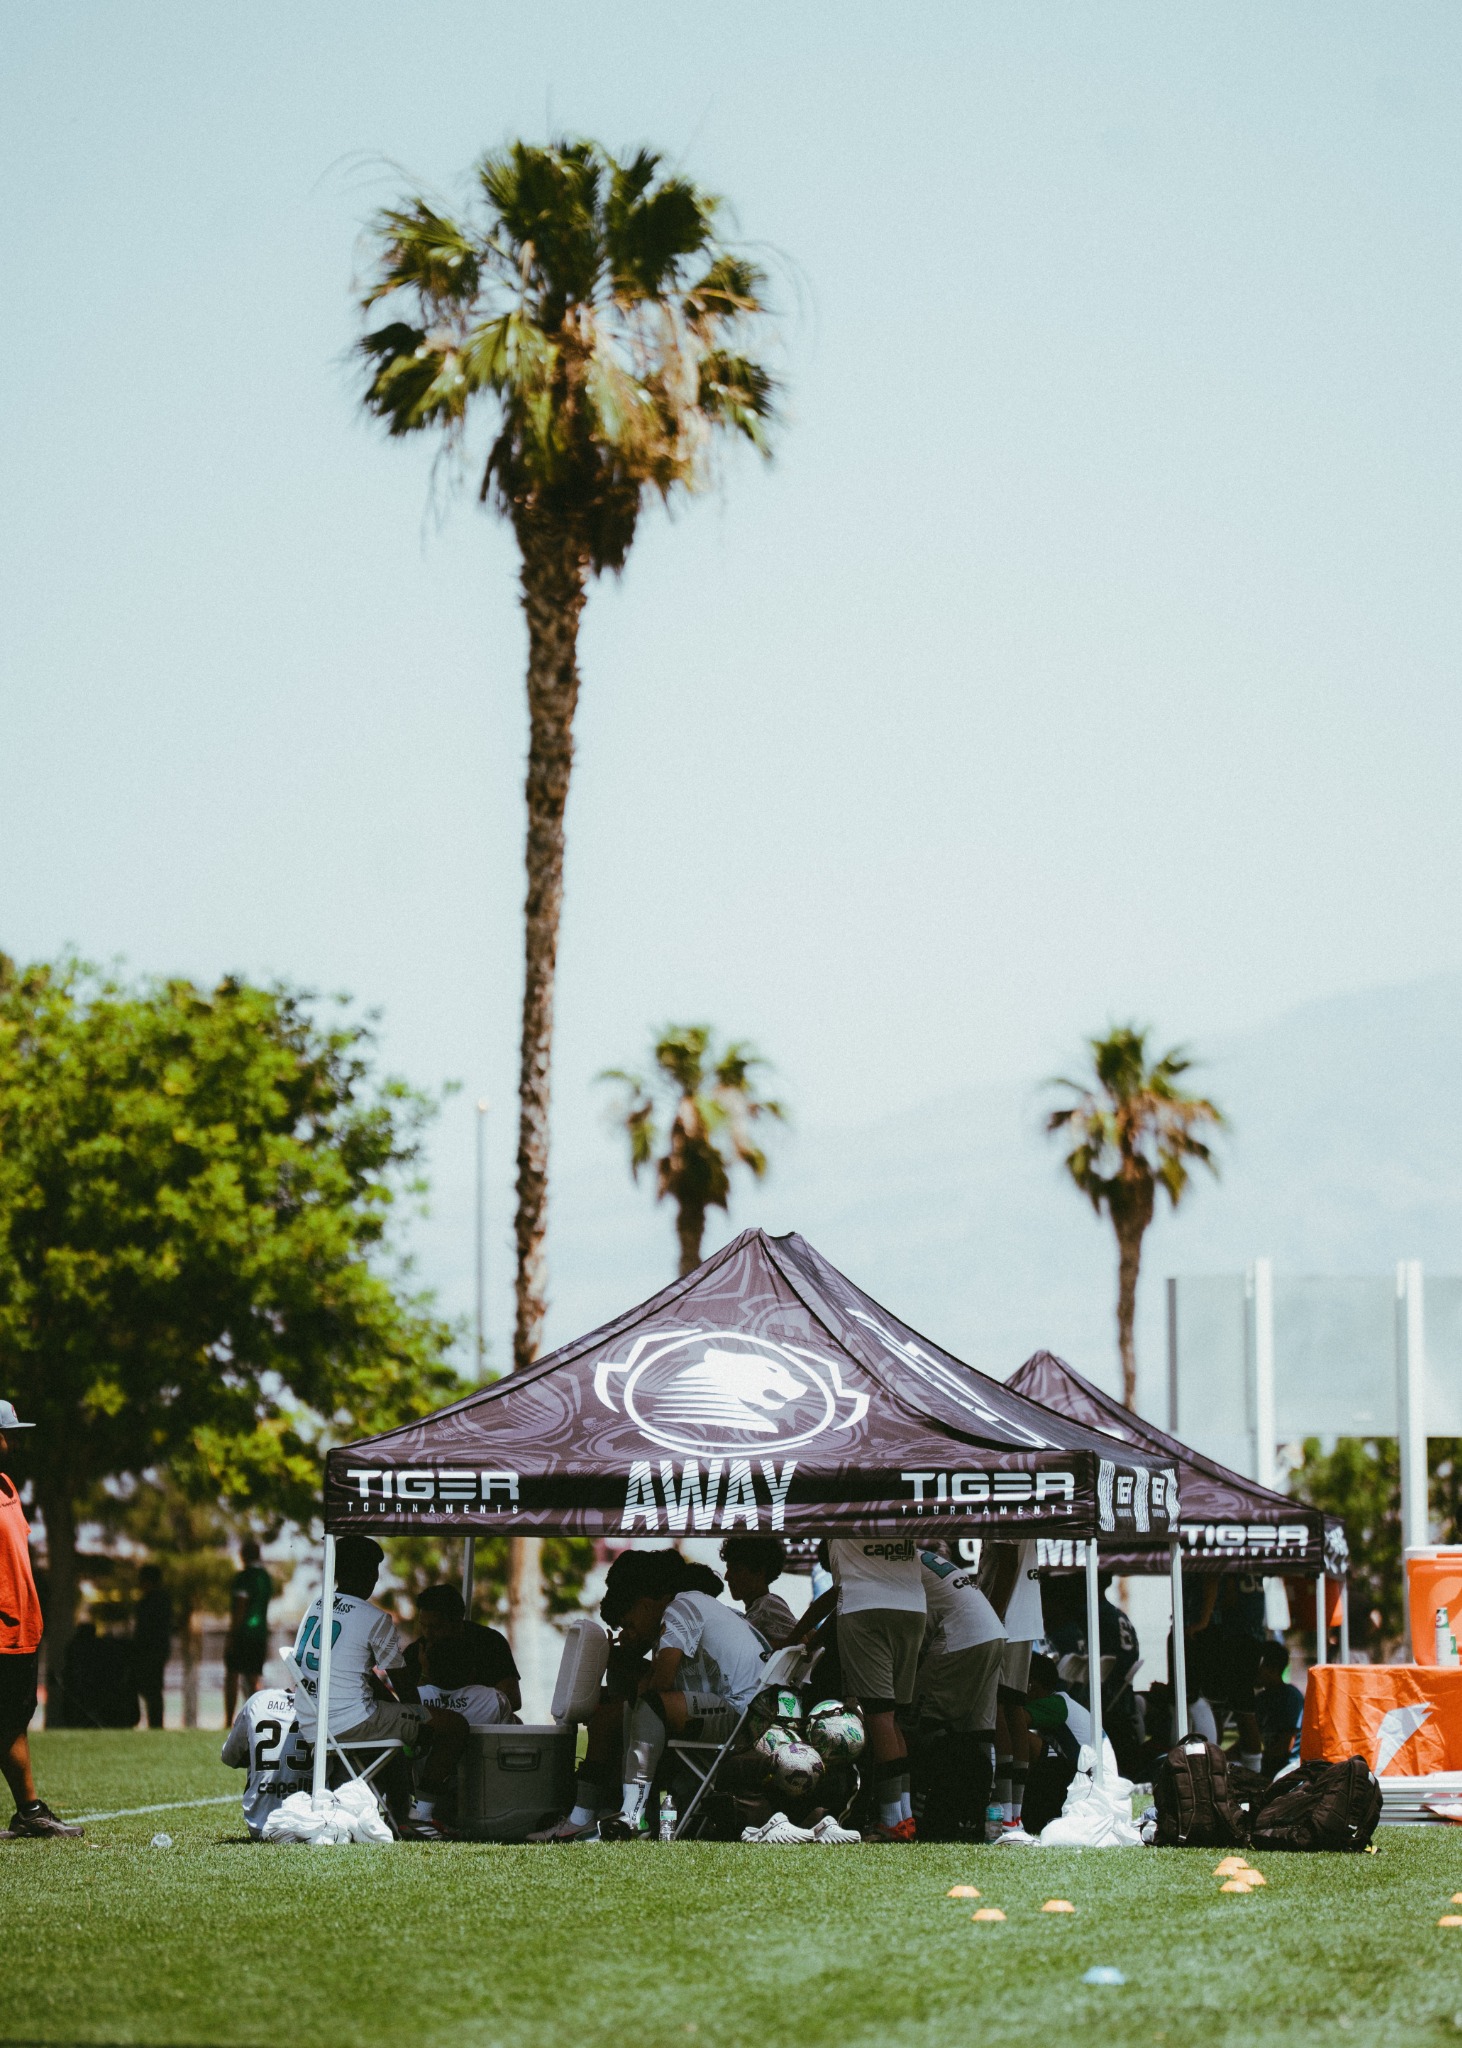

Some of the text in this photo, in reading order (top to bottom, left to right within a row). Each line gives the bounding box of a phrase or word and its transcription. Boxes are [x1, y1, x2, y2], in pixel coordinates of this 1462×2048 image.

[347, 1469, 520, 1500] TIGER
[620, 1460, 799, 1531] AWAY
[901, 1472, 1075, 1502] TIGER
[347, 1501, 519, 1515] TOURNAMENTS
[901, 1505, 1073, 1516] TOURNAMENTS
[1179, 1524, 1310, 1548] TIGER
[863, 1539, 915, 1560] capelli
[295, 1615, 342, 1671] 19
[267, 1700, 286, 1710] BAD
[450, 1697, 468, 1709] ASS
[255, 1720, 314, 1771] 23
